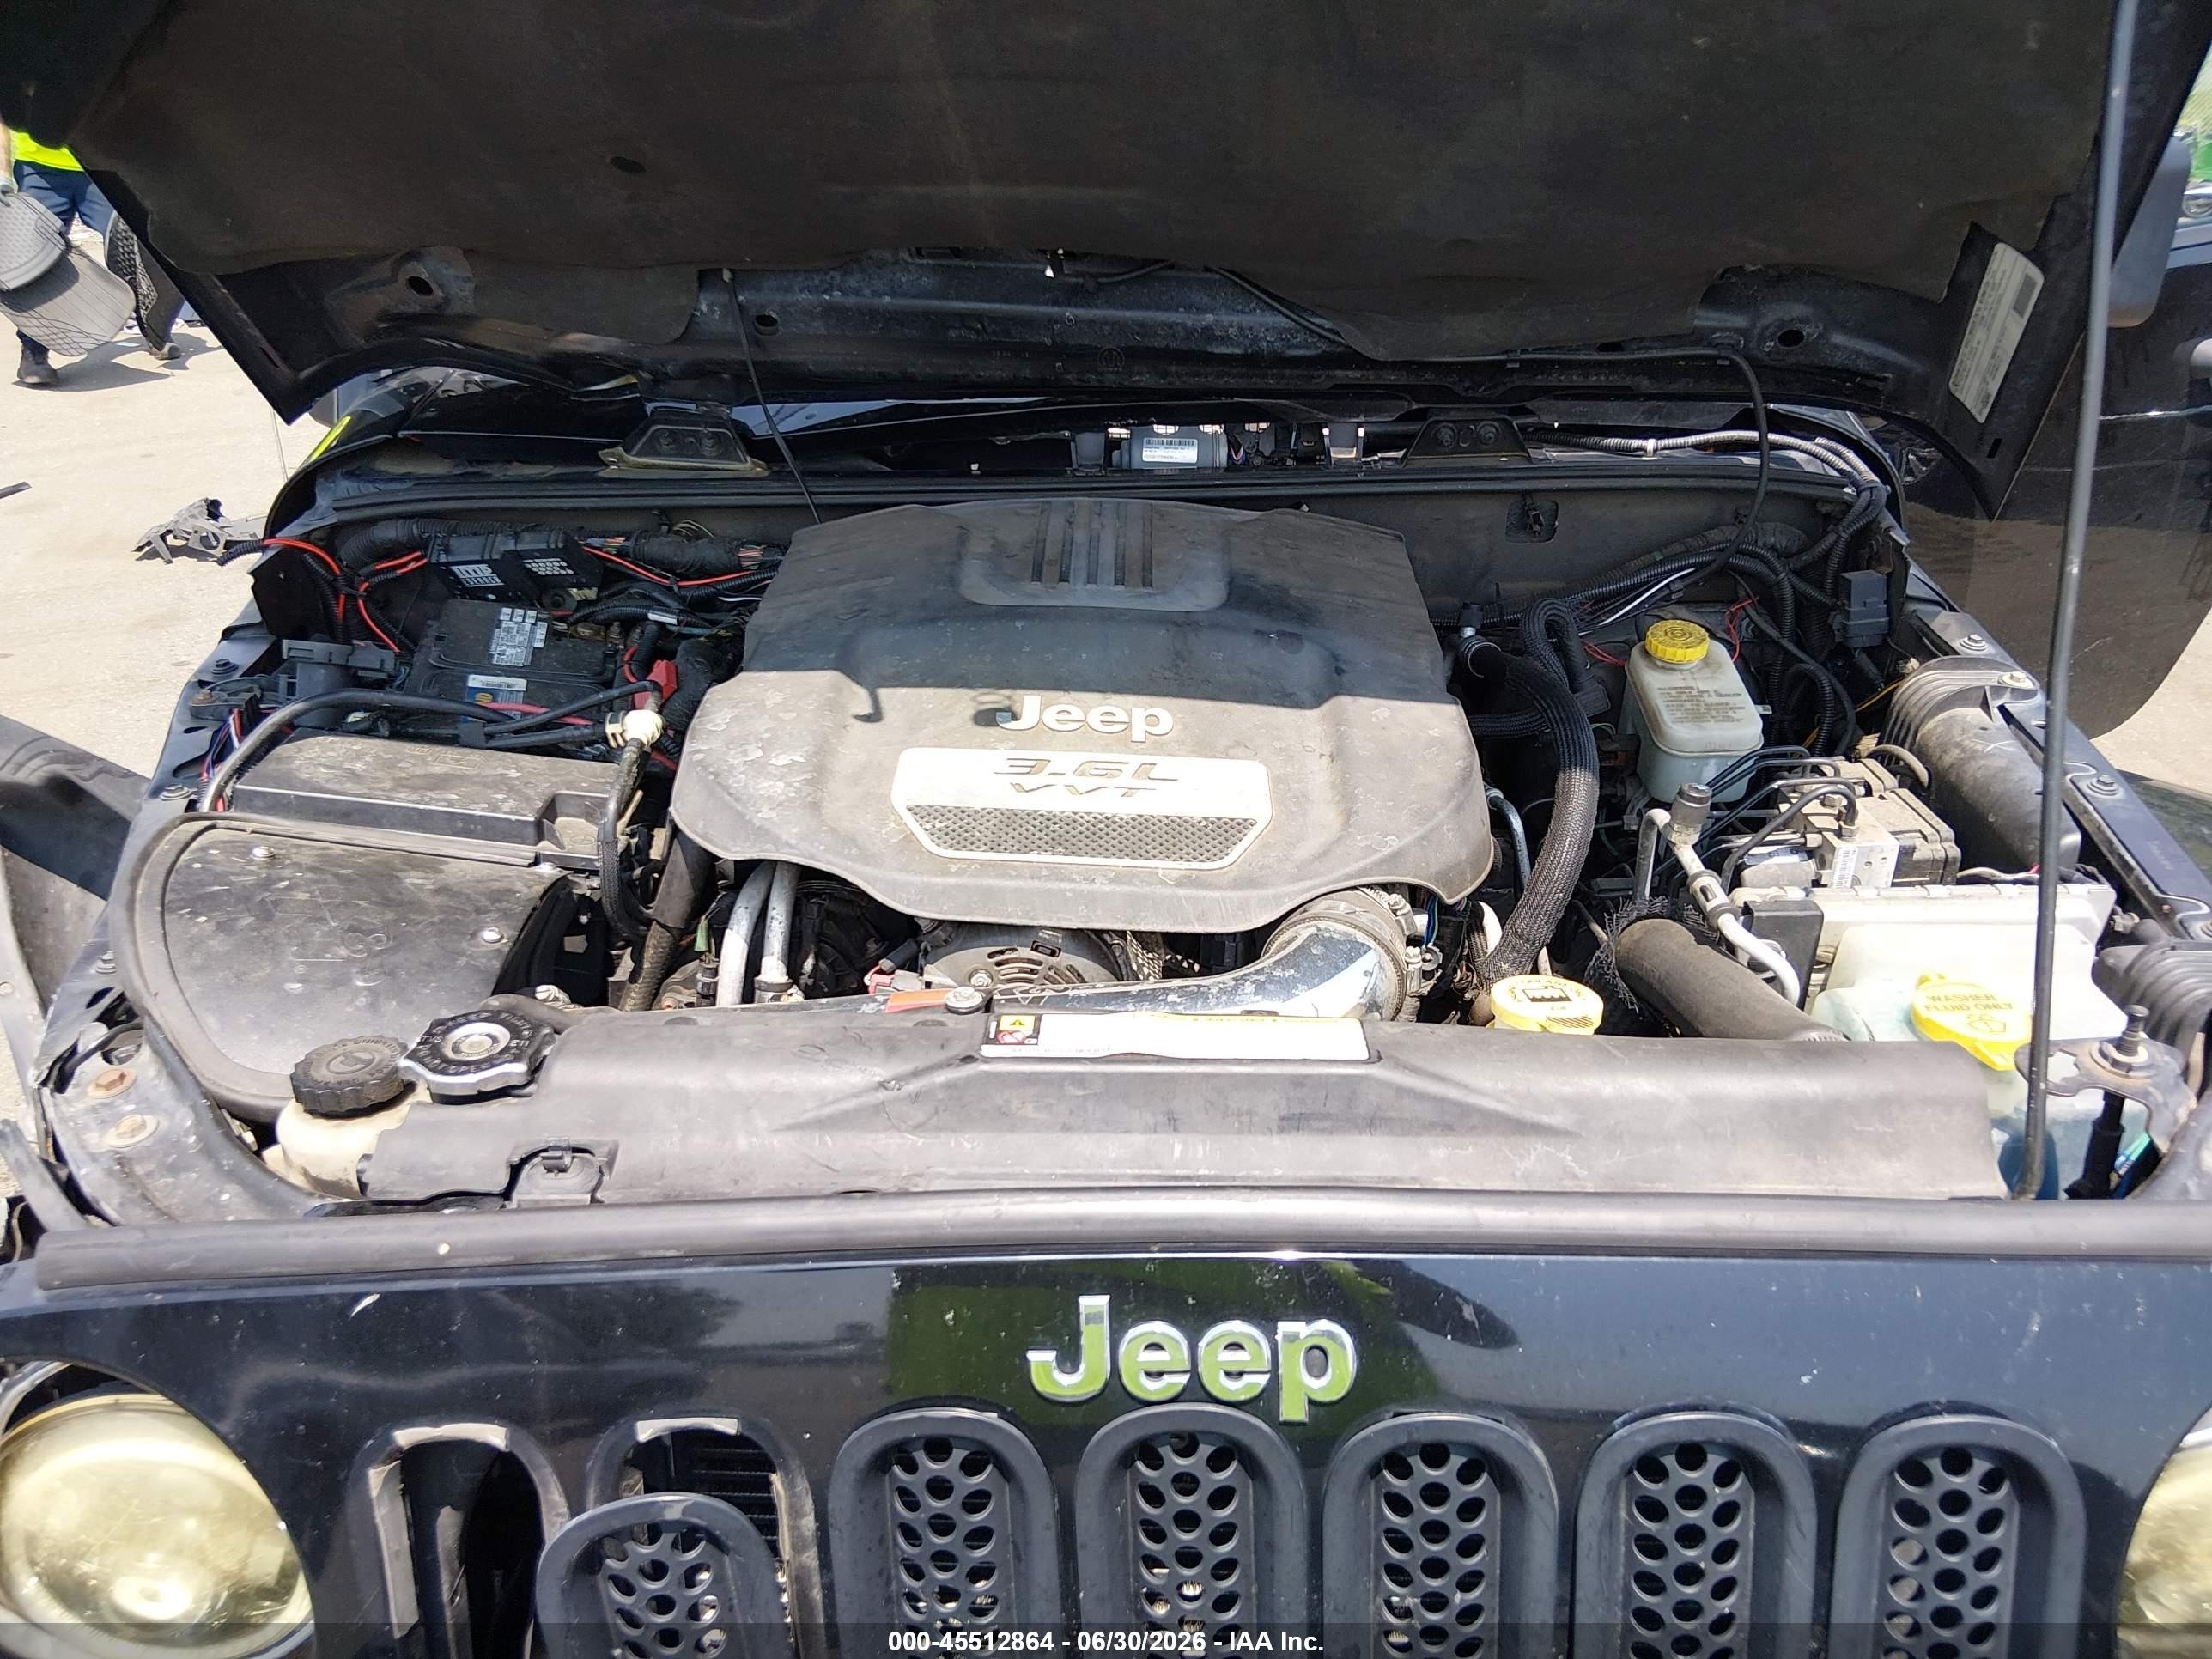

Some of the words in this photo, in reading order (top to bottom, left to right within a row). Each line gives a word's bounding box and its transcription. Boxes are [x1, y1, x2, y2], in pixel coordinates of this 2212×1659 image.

[996, 695, 1175, 743] Jeep
[994, 757, 1179, 781] 3.6L
[1010, 782, 1158, 798] VVT
[501, 1012, 532, 1030] TIGHT
[1026, 1294, 1358, 1425] Jeep
